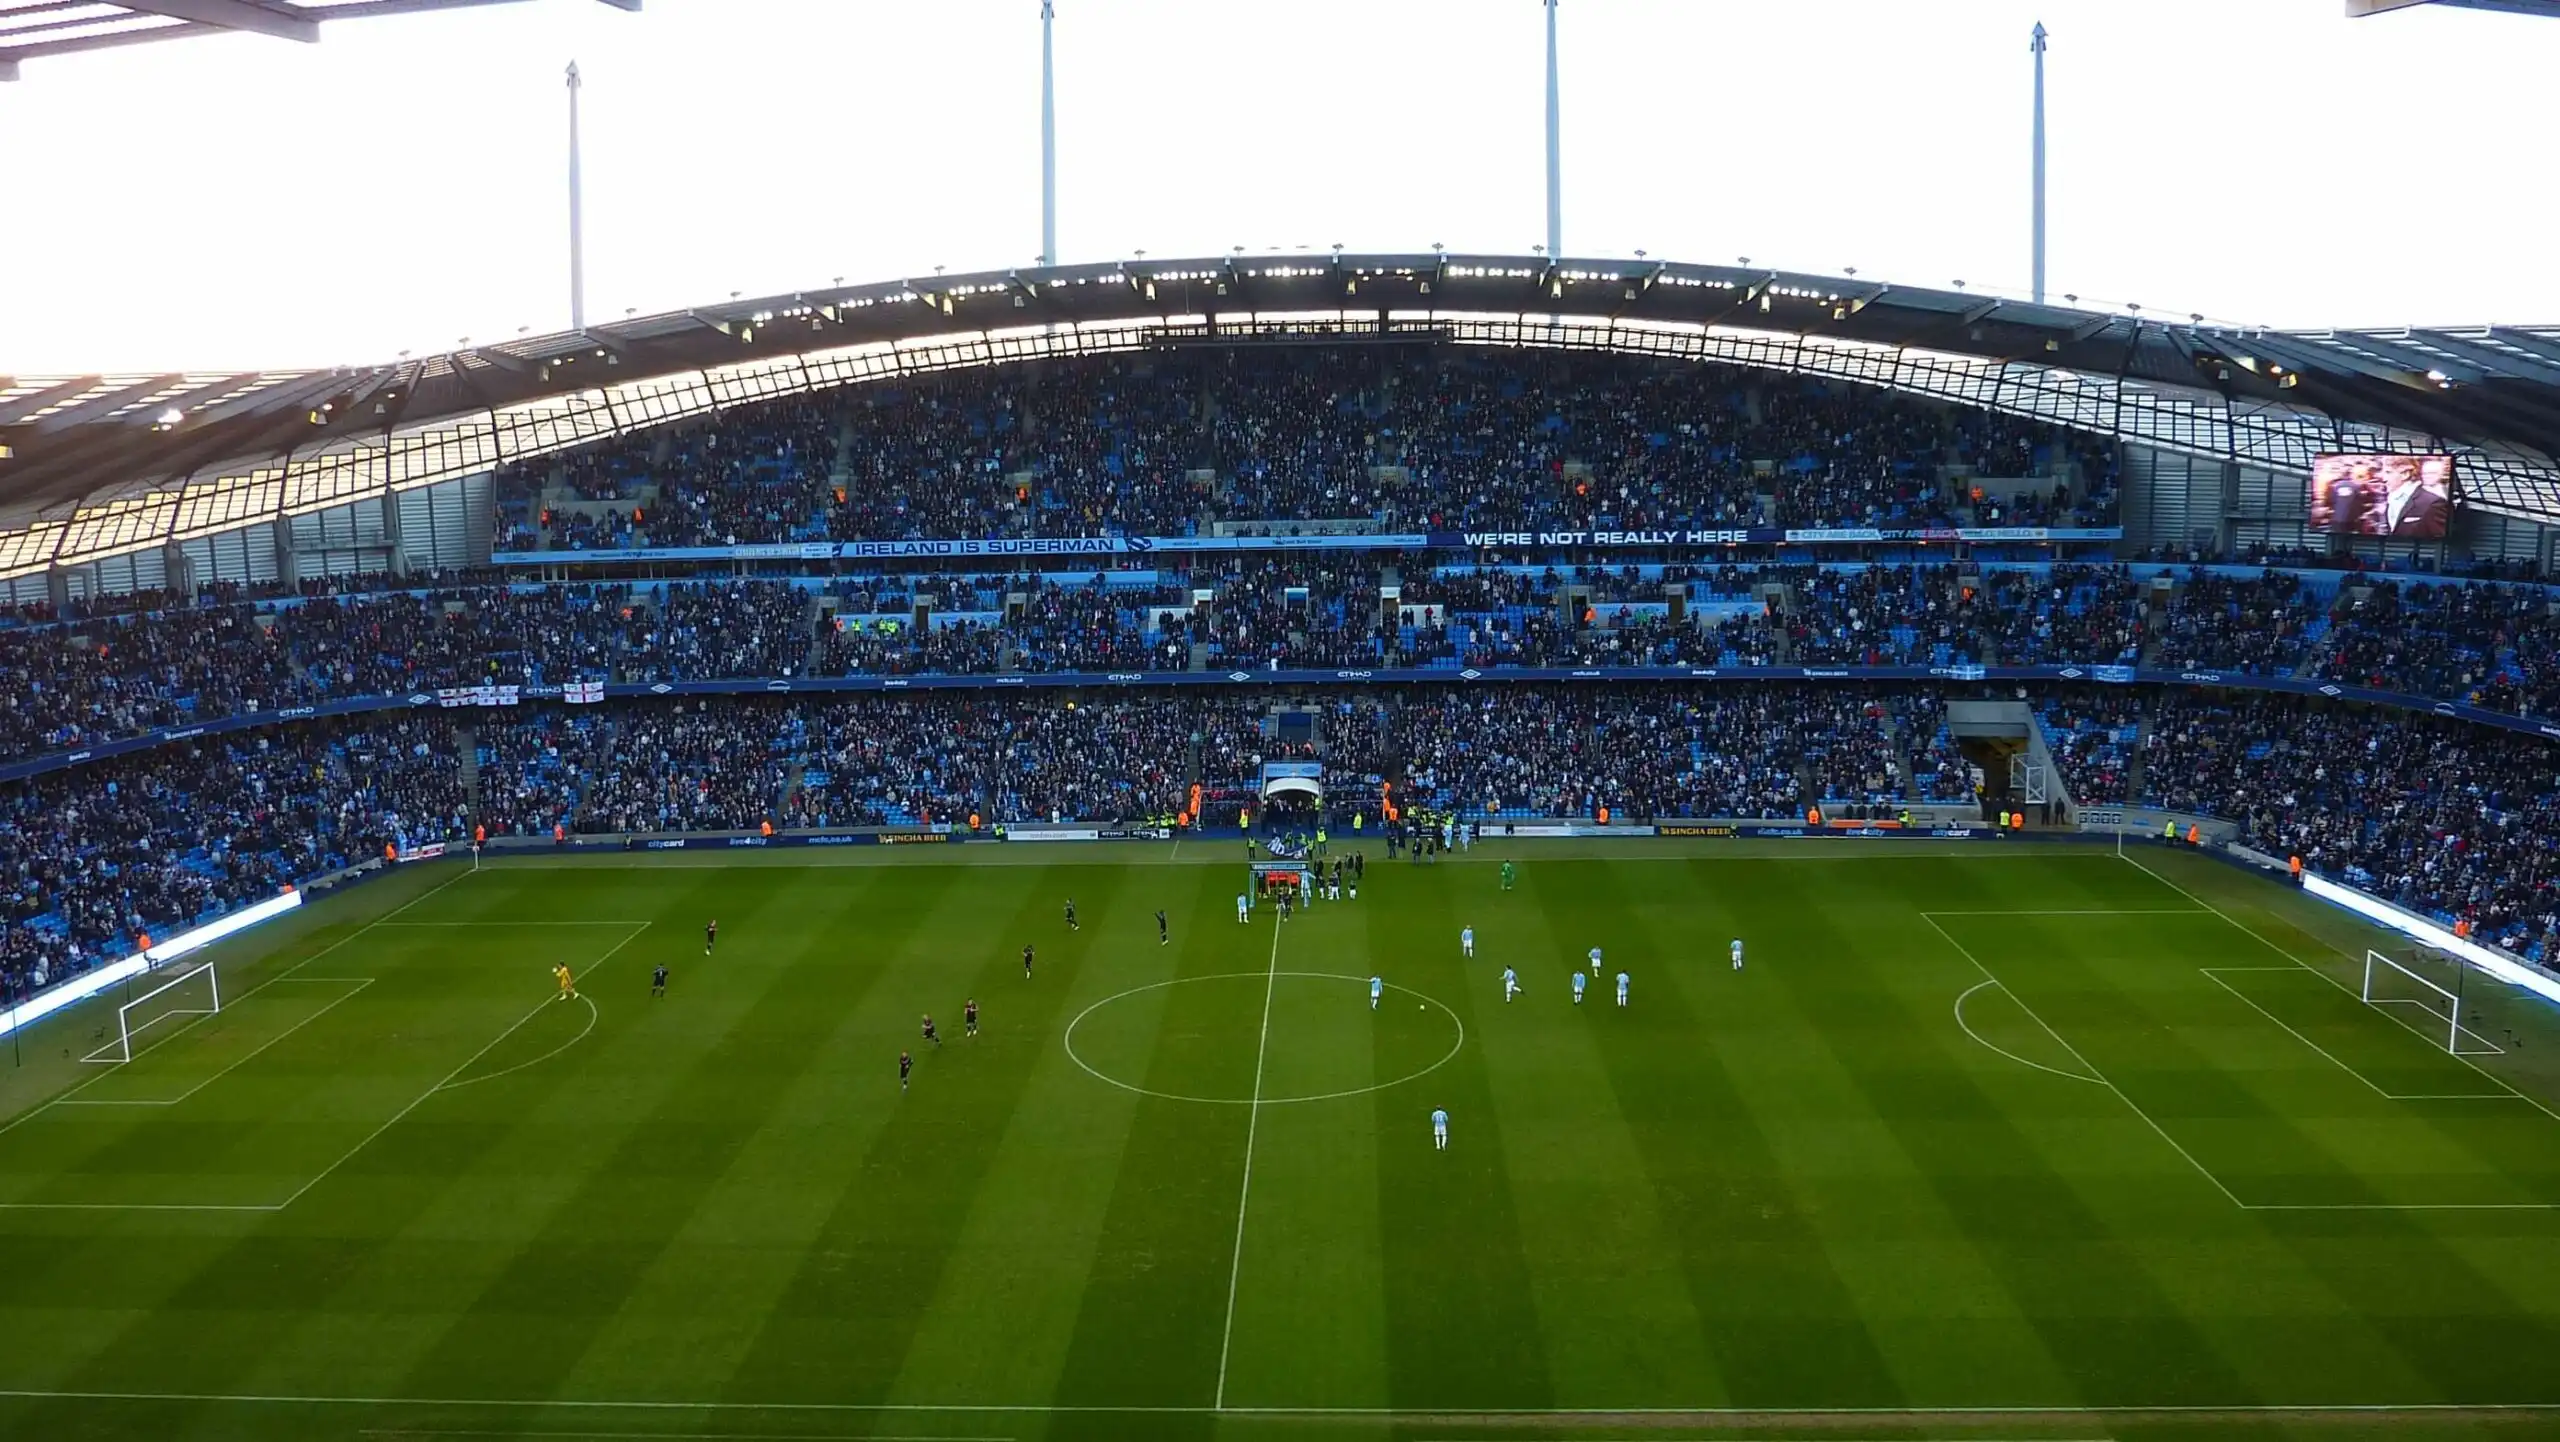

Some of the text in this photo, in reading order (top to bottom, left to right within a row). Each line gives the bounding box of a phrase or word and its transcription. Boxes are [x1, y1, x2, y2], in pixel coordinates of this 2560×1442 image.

[1463, 530, 1748, 546] WE'RE NOT REALLY HERE
[1881, 530, 1905, 538] CITY
[856, 539, 1115, 556] IRELAND IS SUPERMAN
[1337, 670, 1372, 678] ETIHAD
[1668, 828, 1705, 836] SINGHA
[729, 837, 768, 846] live4city
[885, 834, 922, 843] SINGHA
[648, 839, 685, 849] citycard
